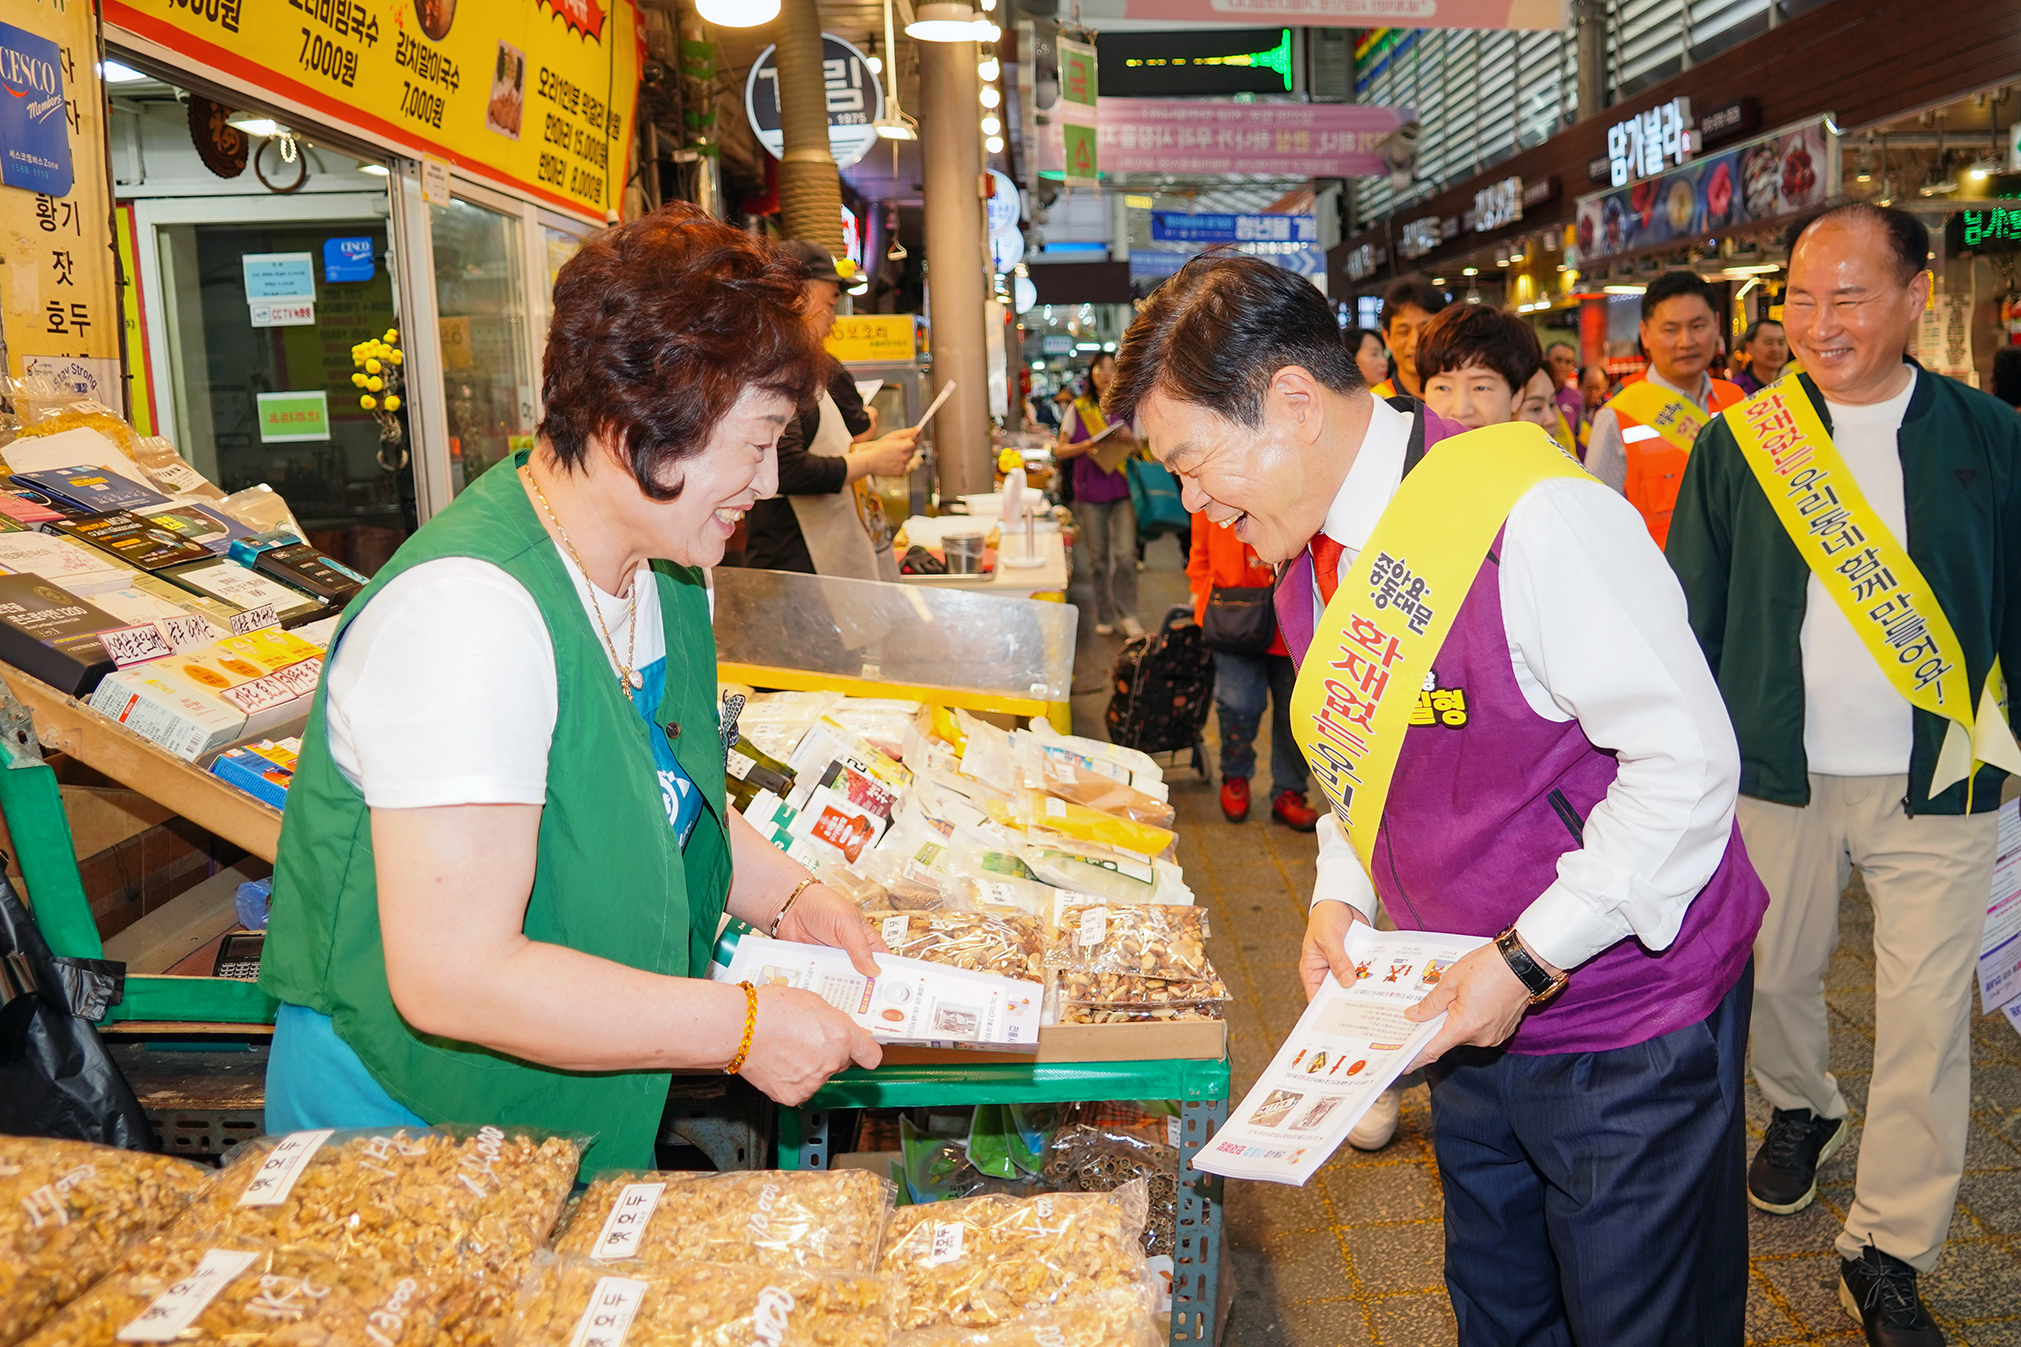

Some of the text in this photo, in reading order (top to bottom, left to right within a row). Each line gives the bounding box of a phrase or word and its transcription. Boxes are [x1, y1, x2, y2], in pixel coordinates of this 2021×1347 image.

[0, 46, 56, 95] CESCO
[299, 28, 358, 88] 7,000원
[395, 31, 460, 94] 김치말이국수
[400, 82, 445, 130] 7,000원
[838, 113, 867, 124] 1975
[36, 193, 80, 236] 황기
[52, 250, 74, 287] 잣
[46, 301, 91, 338] 호두
[71, 362, 98, 389] Strong
[1745, 393, 1814, 477] 화재없는
[1787, 467, 1866, 557] 우리동네
[1836, 548, 1898, 603] 함께
[1869, 593, 1953, 706] 만들어요!
[1311, 613, 1405, 758] 화재없는
